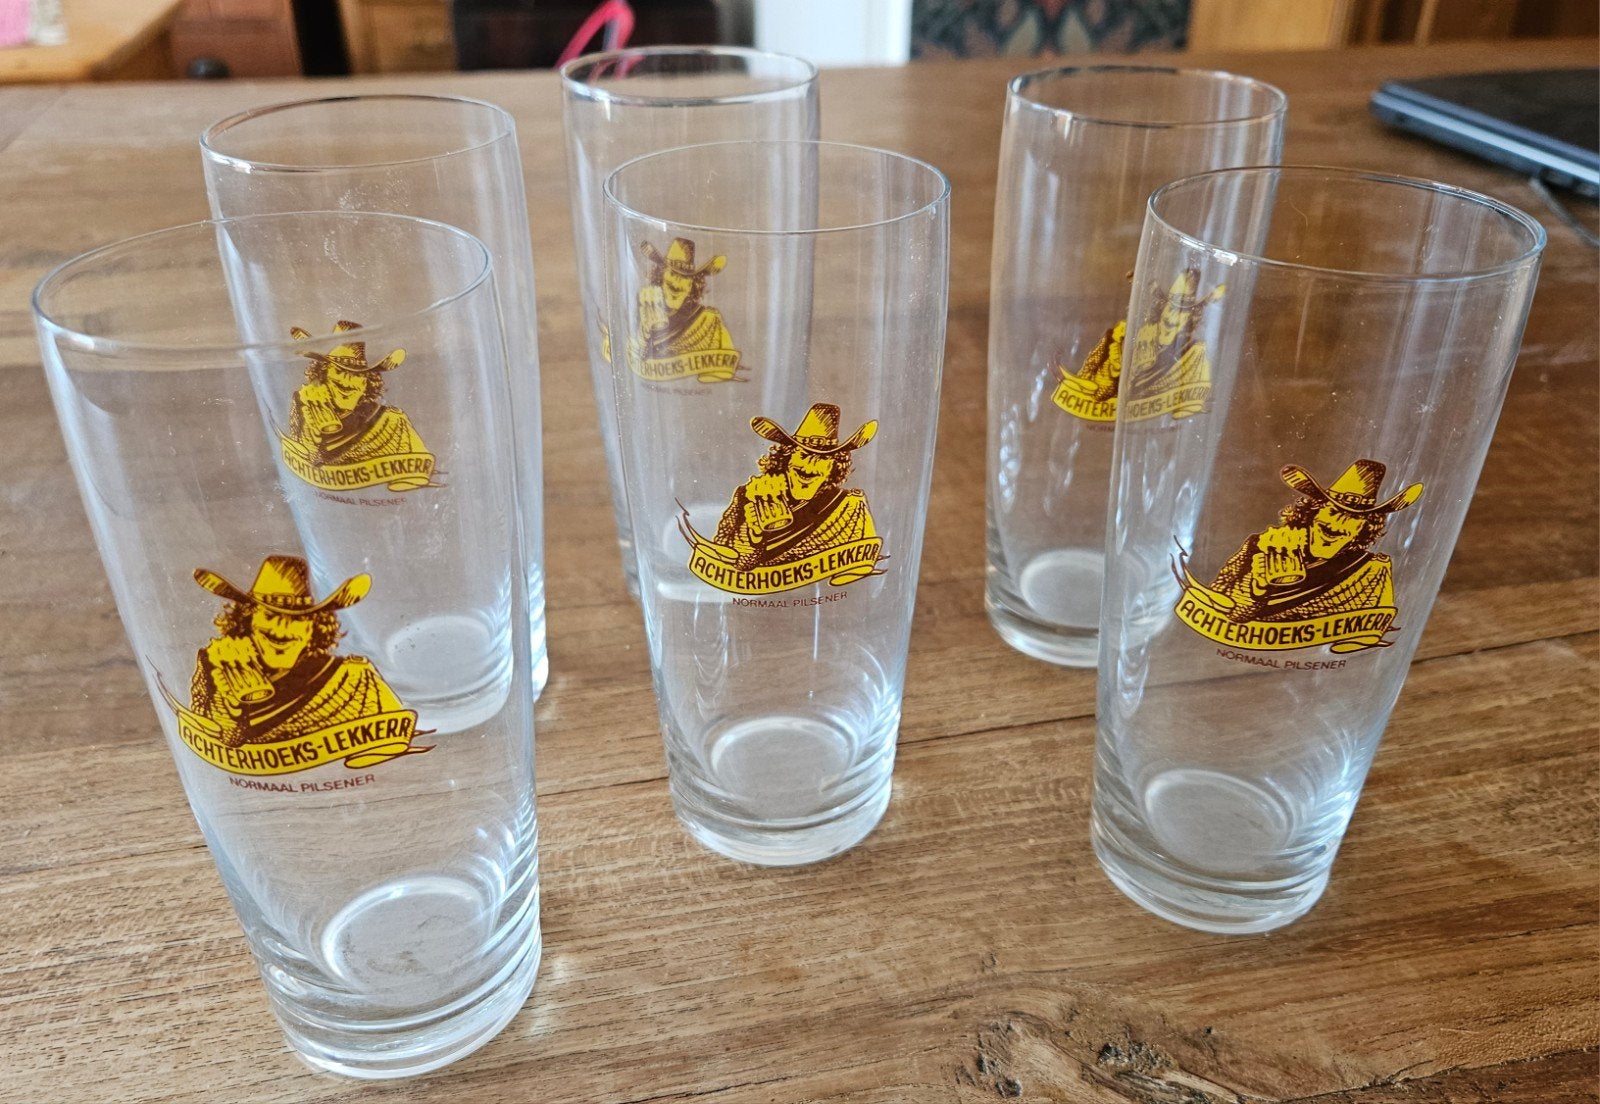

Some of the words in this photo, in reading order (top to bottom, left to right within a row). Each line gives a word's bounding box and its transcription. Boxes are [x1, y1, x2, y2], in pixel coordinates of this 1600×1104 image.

[694, 543, 879, 590] ACHTERHOEKS-LEKKERR
[732, 597, 789, 608] NORMAAL
[793, 591, 848, 607] PILSENER
[1180, 599, 1393, 646] ACHTERHOEKS-LEKKERR
[1216, 648, 1280, 669] NORMAAL
[1284, 659, 1347, 671] PILSENER
[182, 717, 412, 770] ACHTERHOEKS-LEKKERR
[229, 776, 299, 793] NORMAAL
[300, 773, 376, 792] PILSENER
